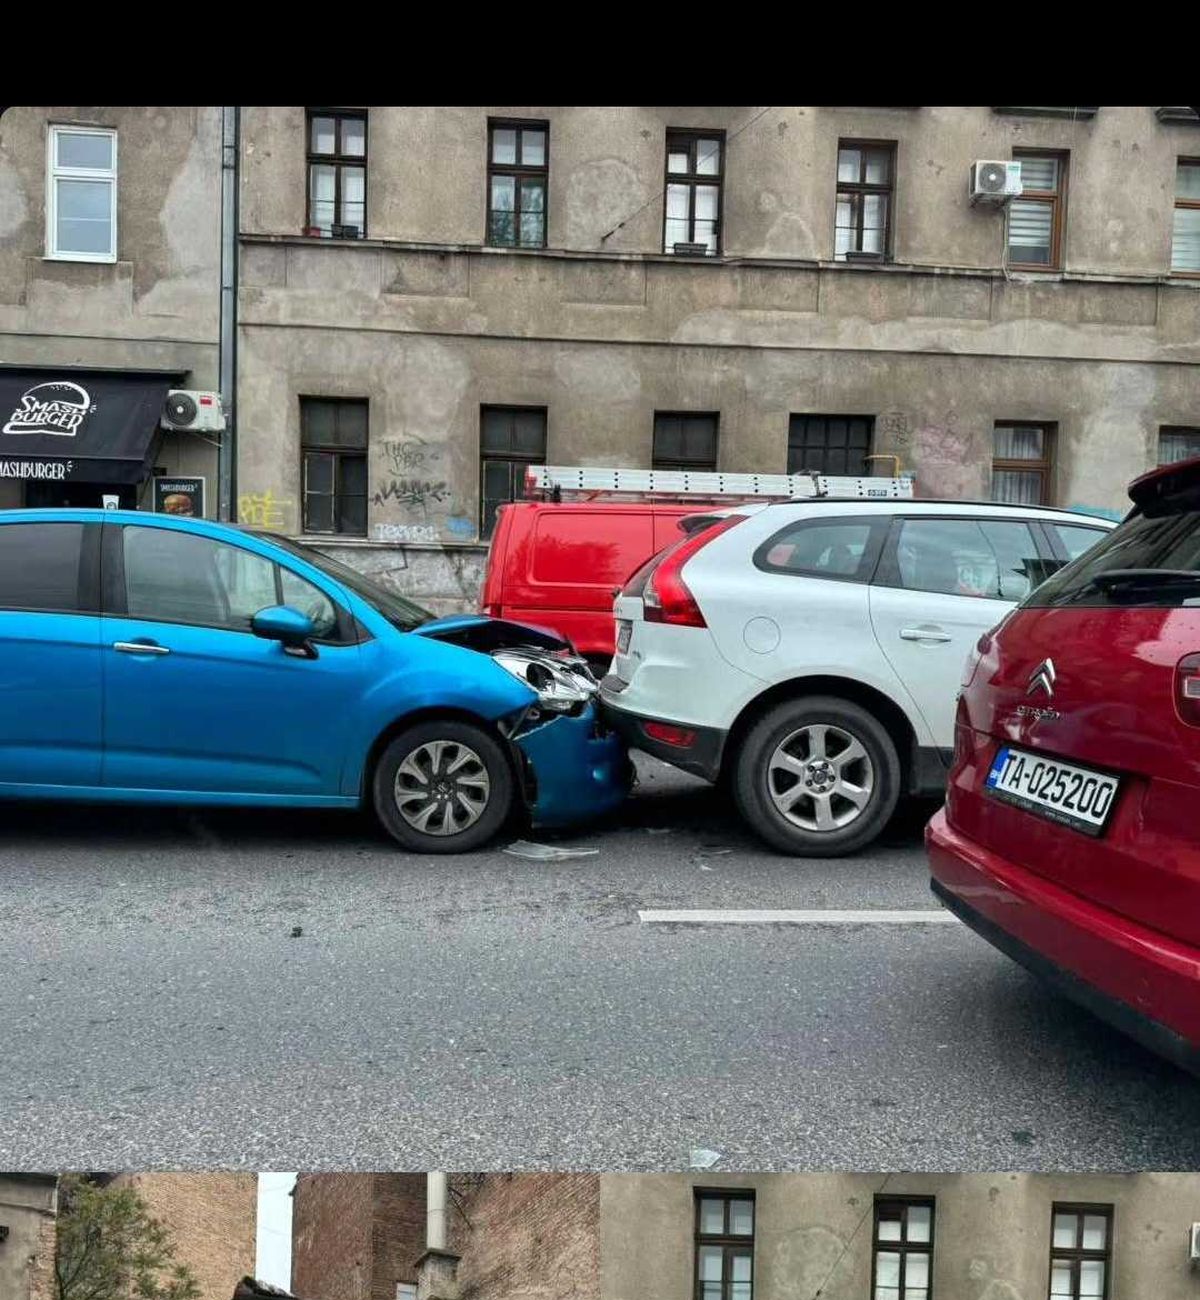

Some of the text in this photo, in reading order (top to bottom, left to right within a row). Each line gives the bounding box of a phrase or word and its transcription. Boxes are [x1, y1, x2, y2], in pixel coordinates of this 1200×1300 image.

[21, 395, 86, 415] SMASH
[10, 411, 83, 430] BURGER
[1001, 754, 1113, 819] TA-025200
